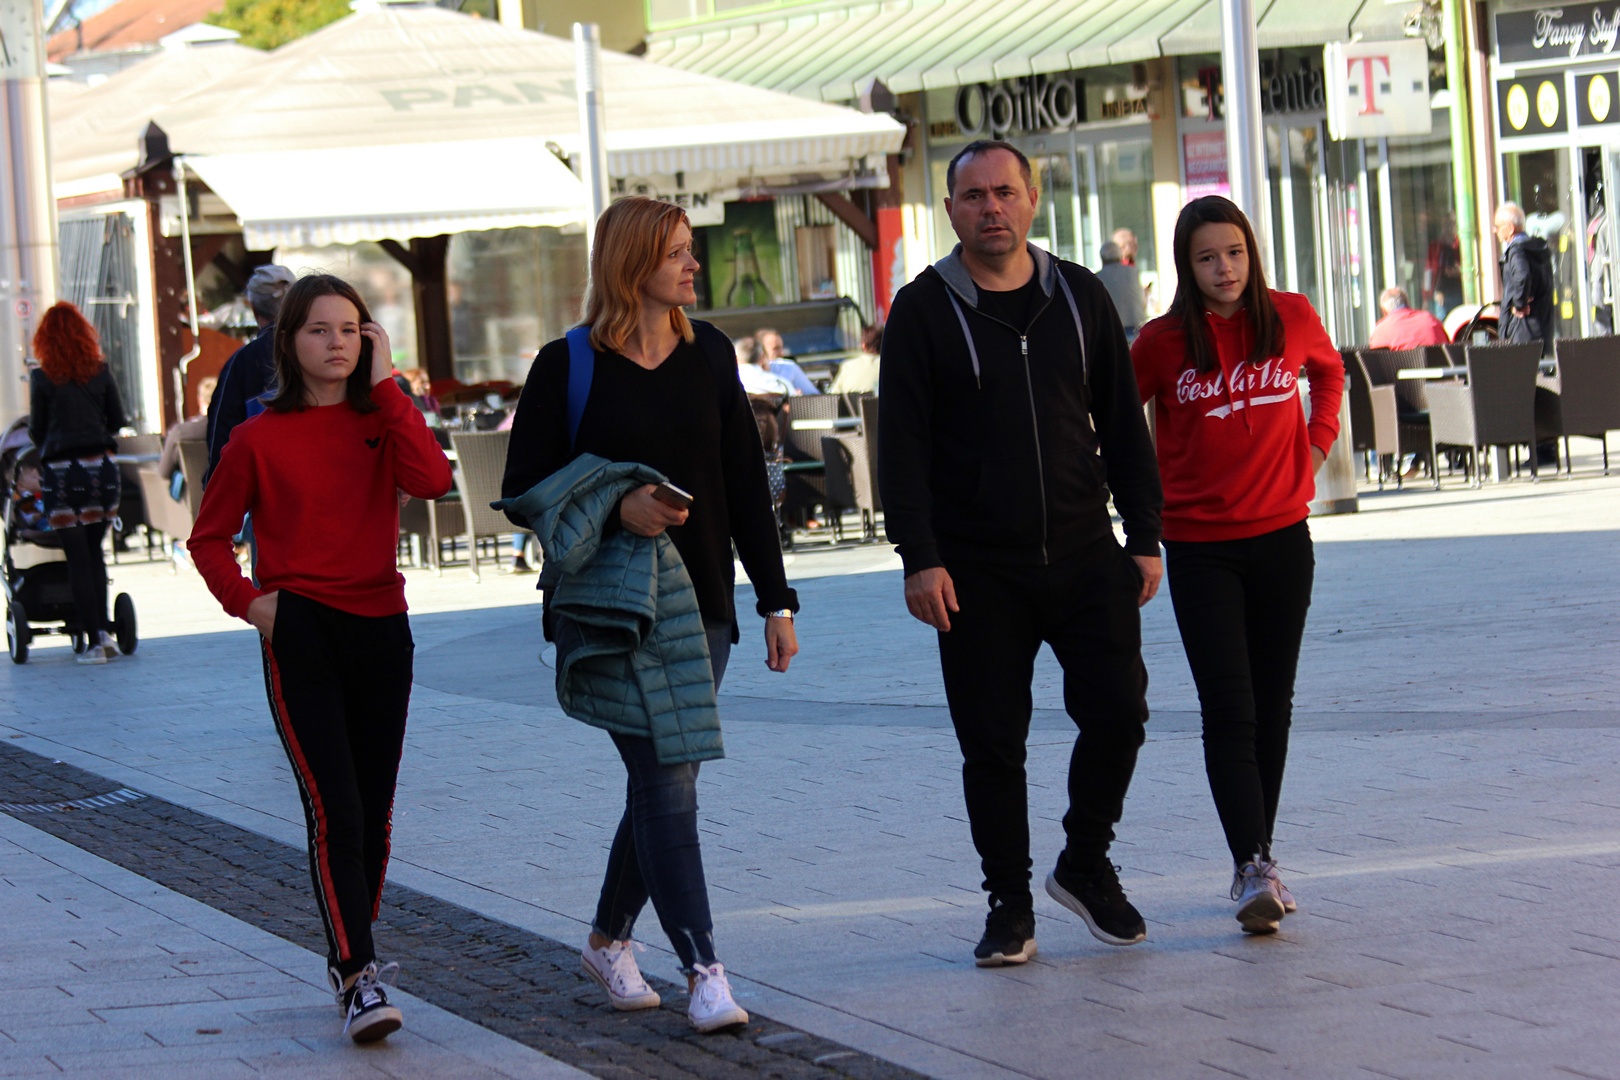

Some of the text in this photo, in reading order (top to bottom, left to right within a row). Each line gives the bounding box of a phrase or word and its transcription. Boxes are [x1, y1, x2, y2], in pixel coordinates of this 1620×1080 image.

[1532, 9, 1585, 59] Fancy
[379, 79, 578, 111] PAN
[955, 75, 1077, 140] Optika
[1229, 360, 1255, 393] la
[1253, 357, 1296, 389] Vie
